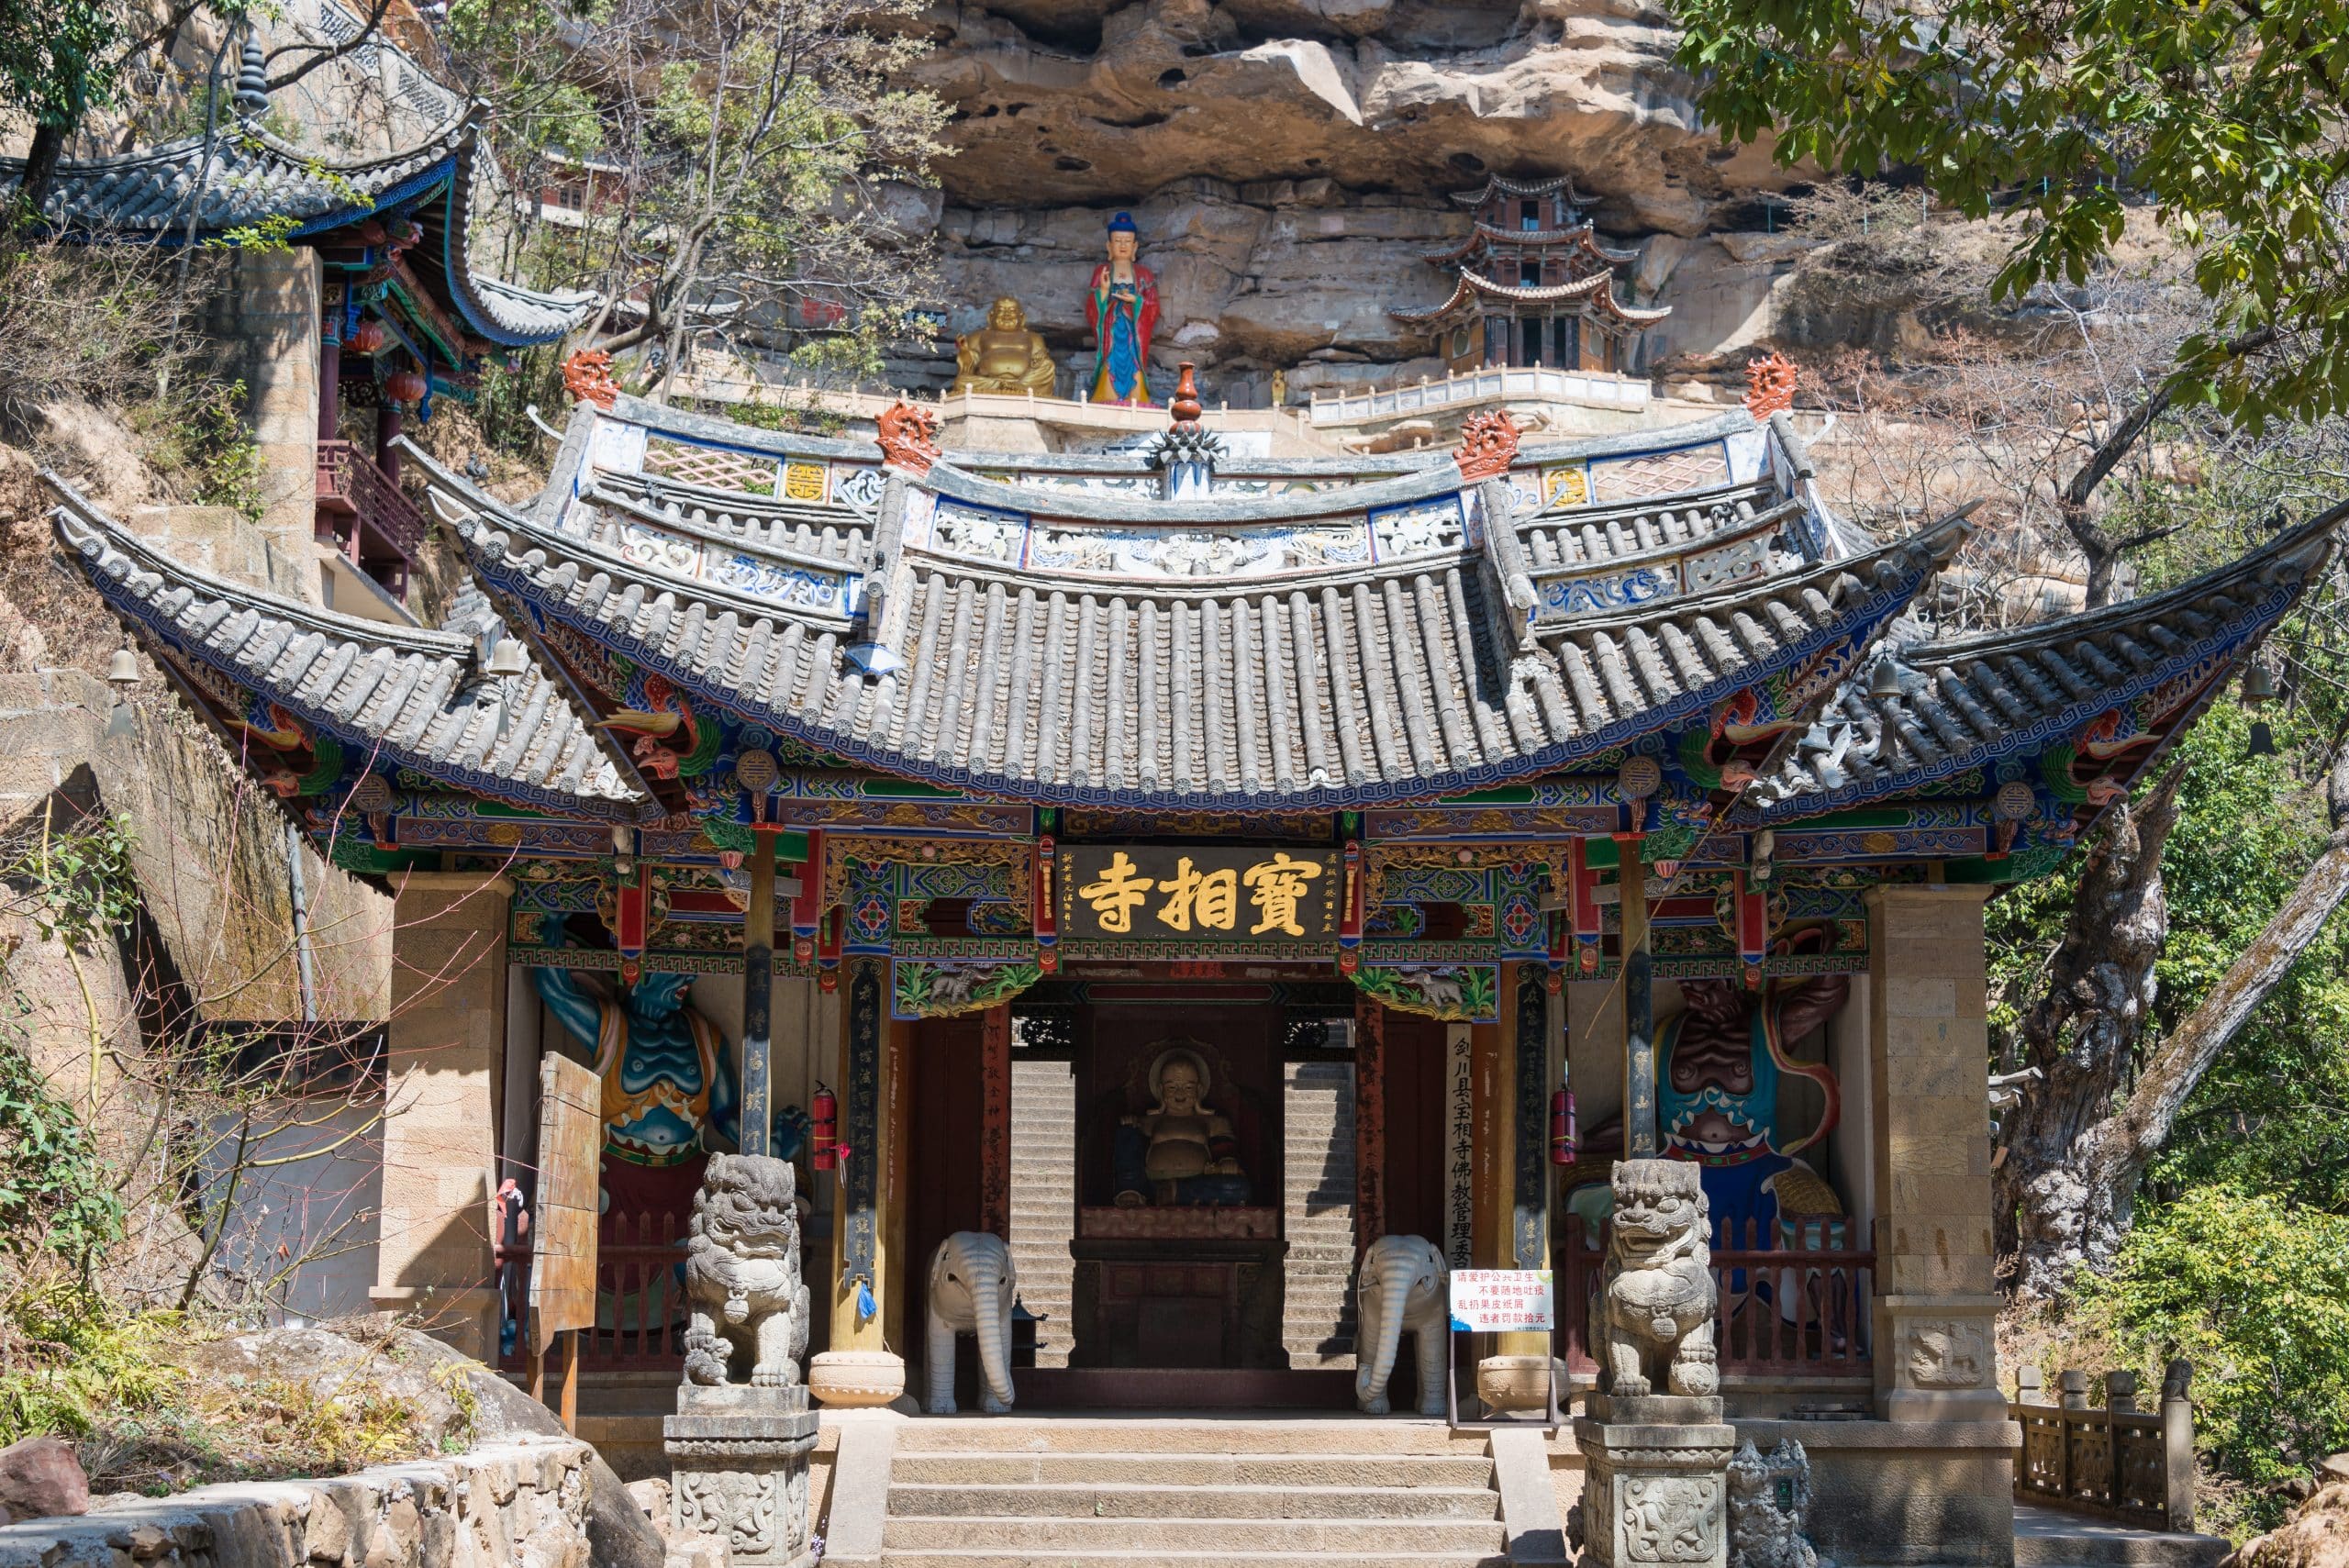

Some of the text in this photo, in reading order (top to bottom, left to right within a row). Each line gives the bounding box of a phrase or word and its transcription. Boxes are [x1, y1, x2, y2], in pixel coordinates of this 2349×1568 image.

[1457, 1272, 1534, 1283] 请爱护公共卫生
[1478, 1284, 1544, 1296] 不要随地吐痰
[1457, 1299, 1524, 1310] 乱扔果皮纸屑
[1479, 1313, 1545, 1324] 违者罚款拾元
